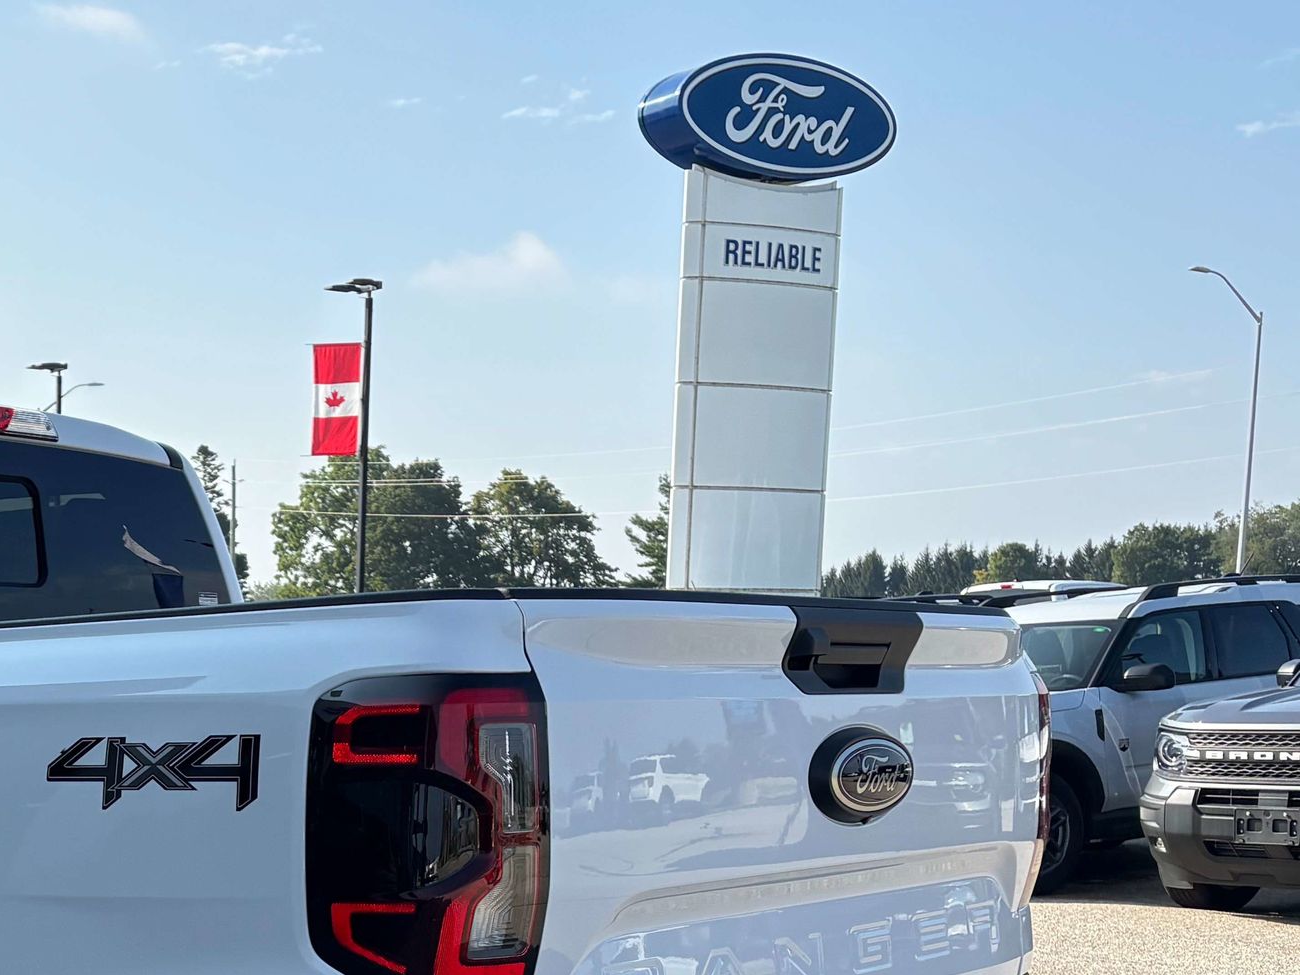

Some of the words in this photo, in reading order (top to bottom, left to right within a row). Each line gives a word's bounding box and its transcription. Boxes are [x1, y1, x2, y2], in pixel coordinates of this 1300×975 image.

[725, 72, 855, 156] Ford
[724, 238, 822, 274] RELIABLE
[856, 755, 899, 794] Ford
